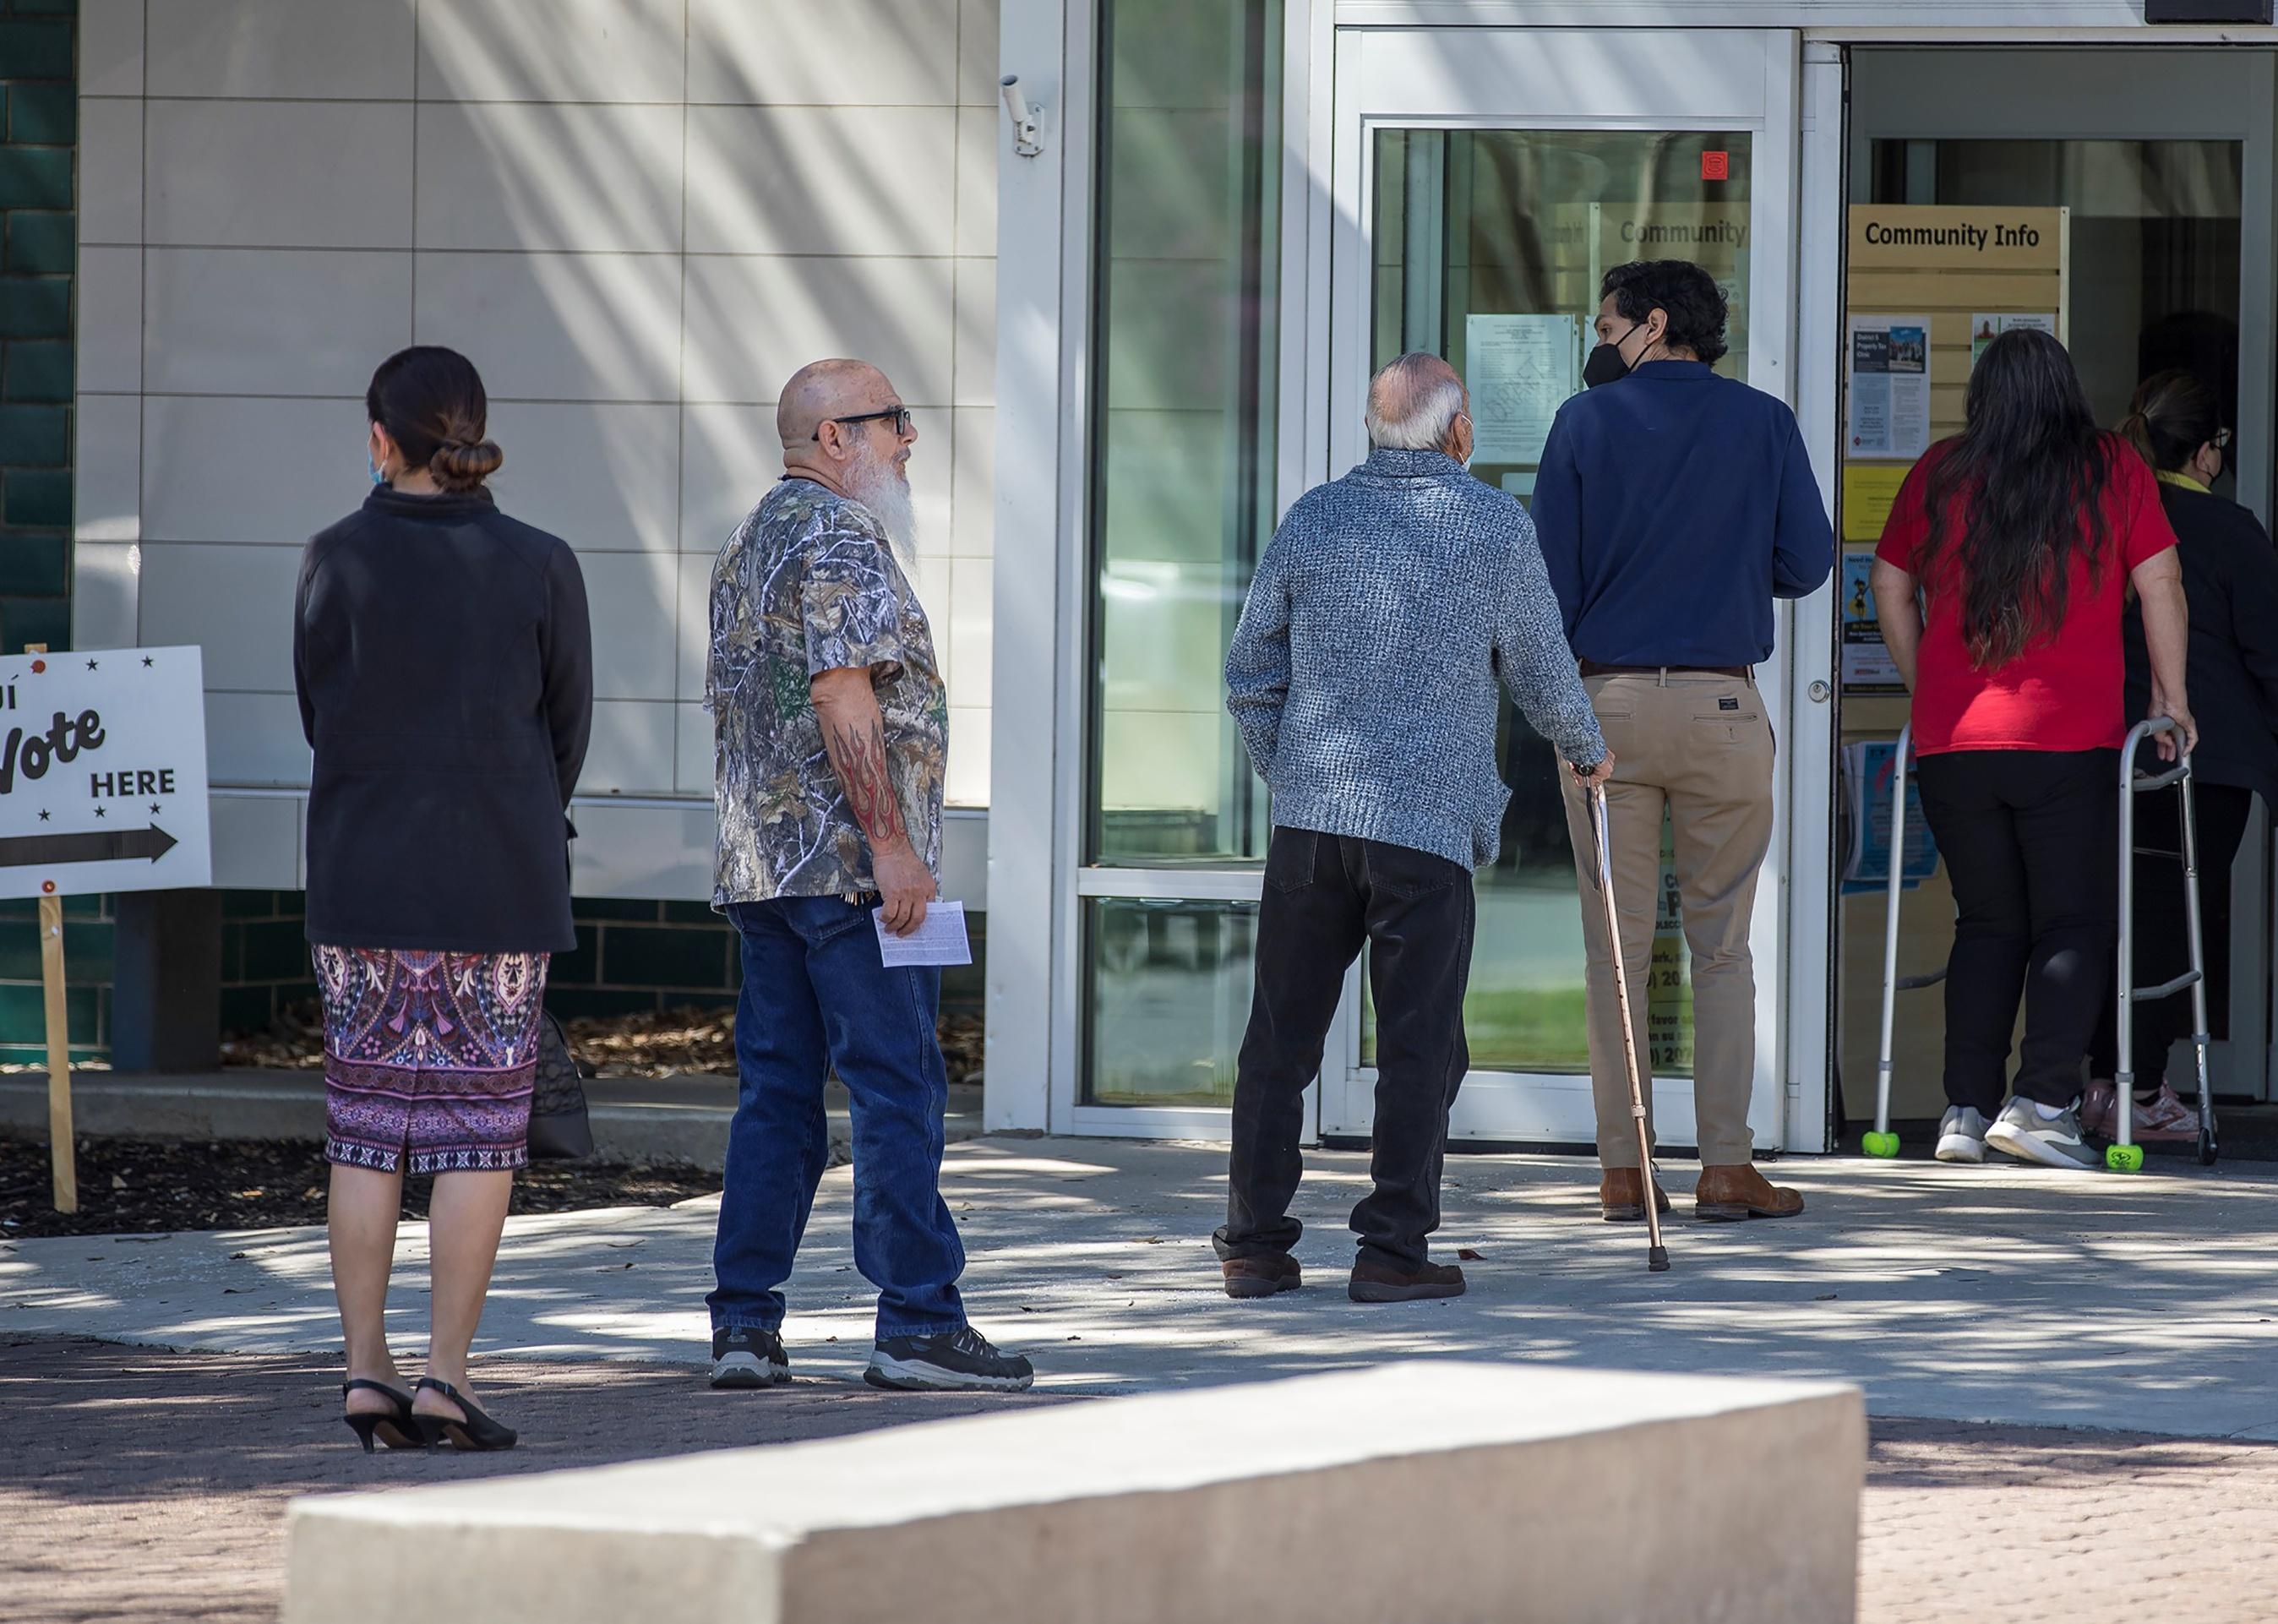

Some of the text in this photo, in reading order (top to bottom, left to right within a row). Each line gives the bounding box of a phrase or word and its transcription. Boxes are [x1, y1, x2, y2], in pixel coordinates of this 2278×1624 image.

[1620, 220, 1747, 248] Community
[1866, 223, 2040, 251] Community Info
[90, 768, 175, 798] HERE
[1651, 1014, 1678, 1025] favor
